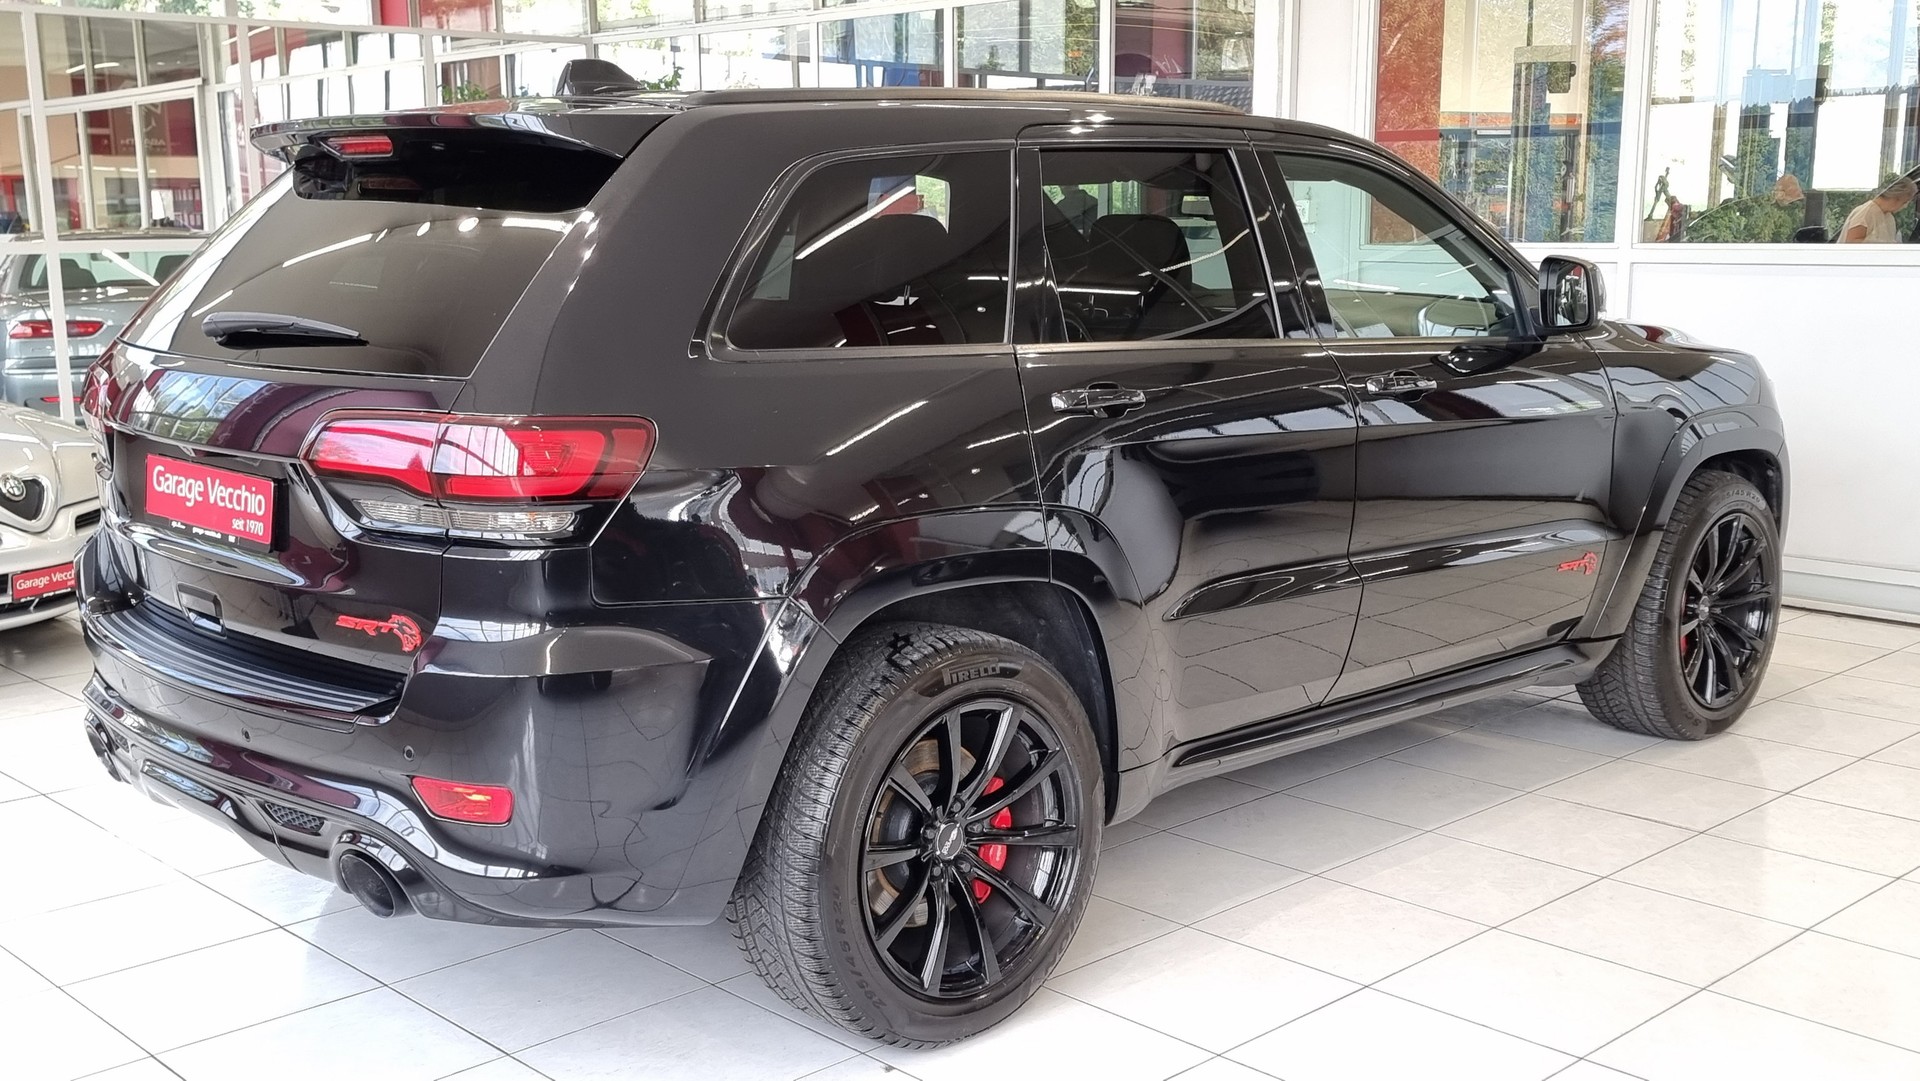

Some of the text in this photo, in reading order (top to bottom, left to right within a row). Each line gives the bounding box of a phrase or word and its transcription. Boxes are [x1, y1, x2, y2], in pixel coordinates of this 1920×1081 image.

[153, 465, 265, 516] Garage Vecchio
[231, 518, 245, 532] seit
[246, 519, 264, 536] 1970
[16, 575, 50, 590] Garage
[335, 615, 399, 636] SRT
[941, 657, 1000, 686] PIRELLI
